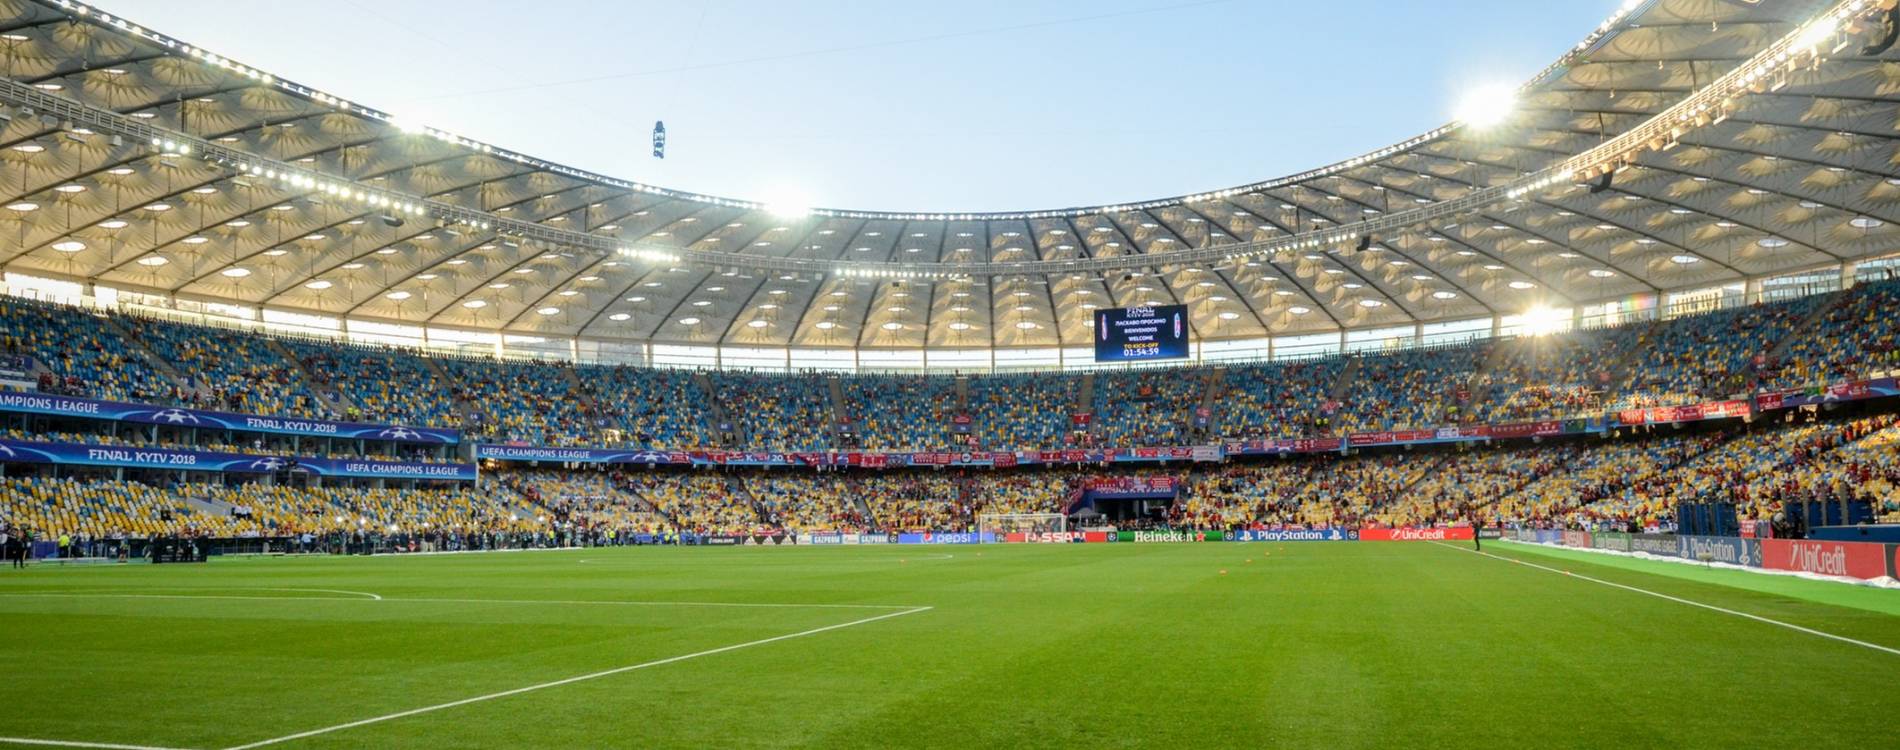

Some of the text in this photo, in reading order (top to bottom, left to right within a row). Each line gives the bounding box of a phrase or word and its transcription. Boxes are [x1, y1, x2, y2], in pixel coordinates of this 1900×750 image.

[1123, 348, 1159, 357] 01:54:59
[56, 401, 99, 414] LEAGUE
[247, 418, 337, 433] FINAL KYIV 2018
[89, 449, 196, 465] FINAL KYIV 2018
[482, 447, 590, 459] UEFA CHAMPIONS LEAGUE
[346, 463, 459, 476] UEFA CHAMPIONS LEAGUE
[936, 533, 971, 543] pepsi
[1134, 531, 1194, 543] Heineken
[1257, 530, 1323, 540] PlayStation
[1402, 529, 1445, 540] UniCredit
[1800, 544, 1846, 575] UniCredit
